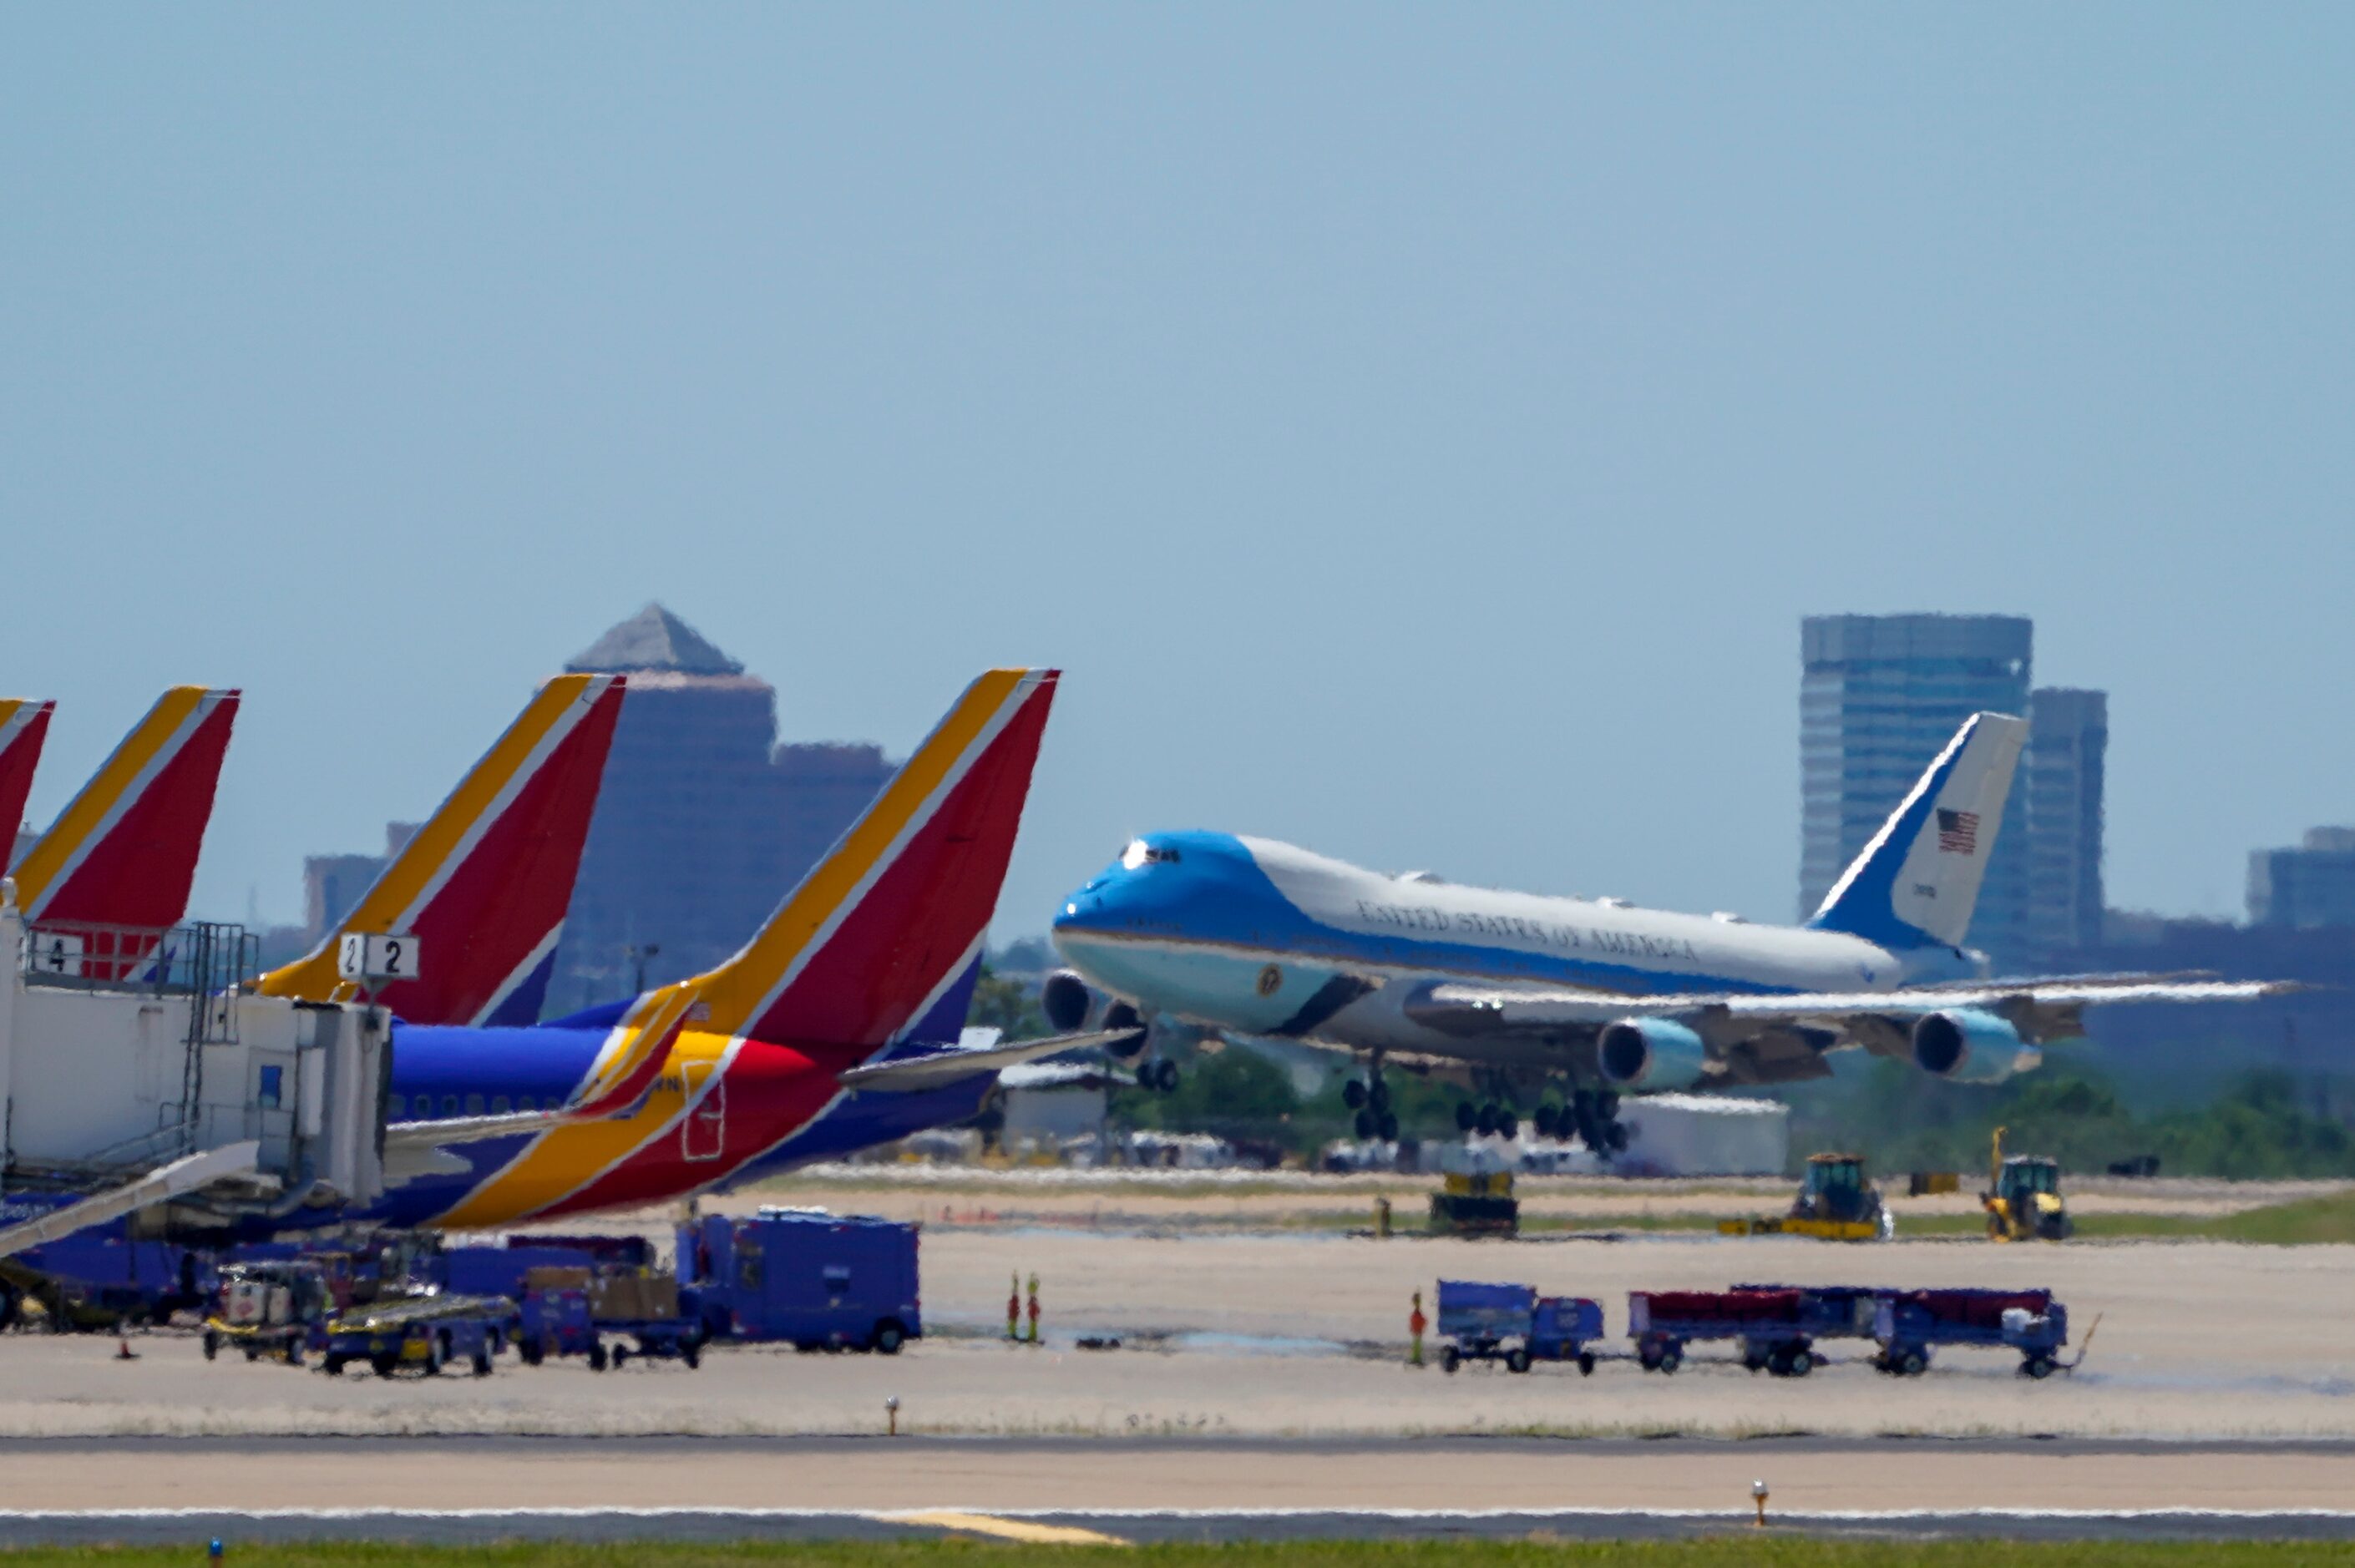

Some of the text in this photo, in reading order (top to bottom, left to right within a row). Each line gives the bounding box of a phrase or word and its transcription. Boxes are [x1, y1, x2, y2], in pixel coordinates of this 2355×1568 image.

[1356, 899, 1450, 931] UNITED
[1456, 912, 1548, 944] STATES
[49, 939, 65, 972] 4
[346, 938, 355, 973] 2
[386, 940, 401, 974] 2
